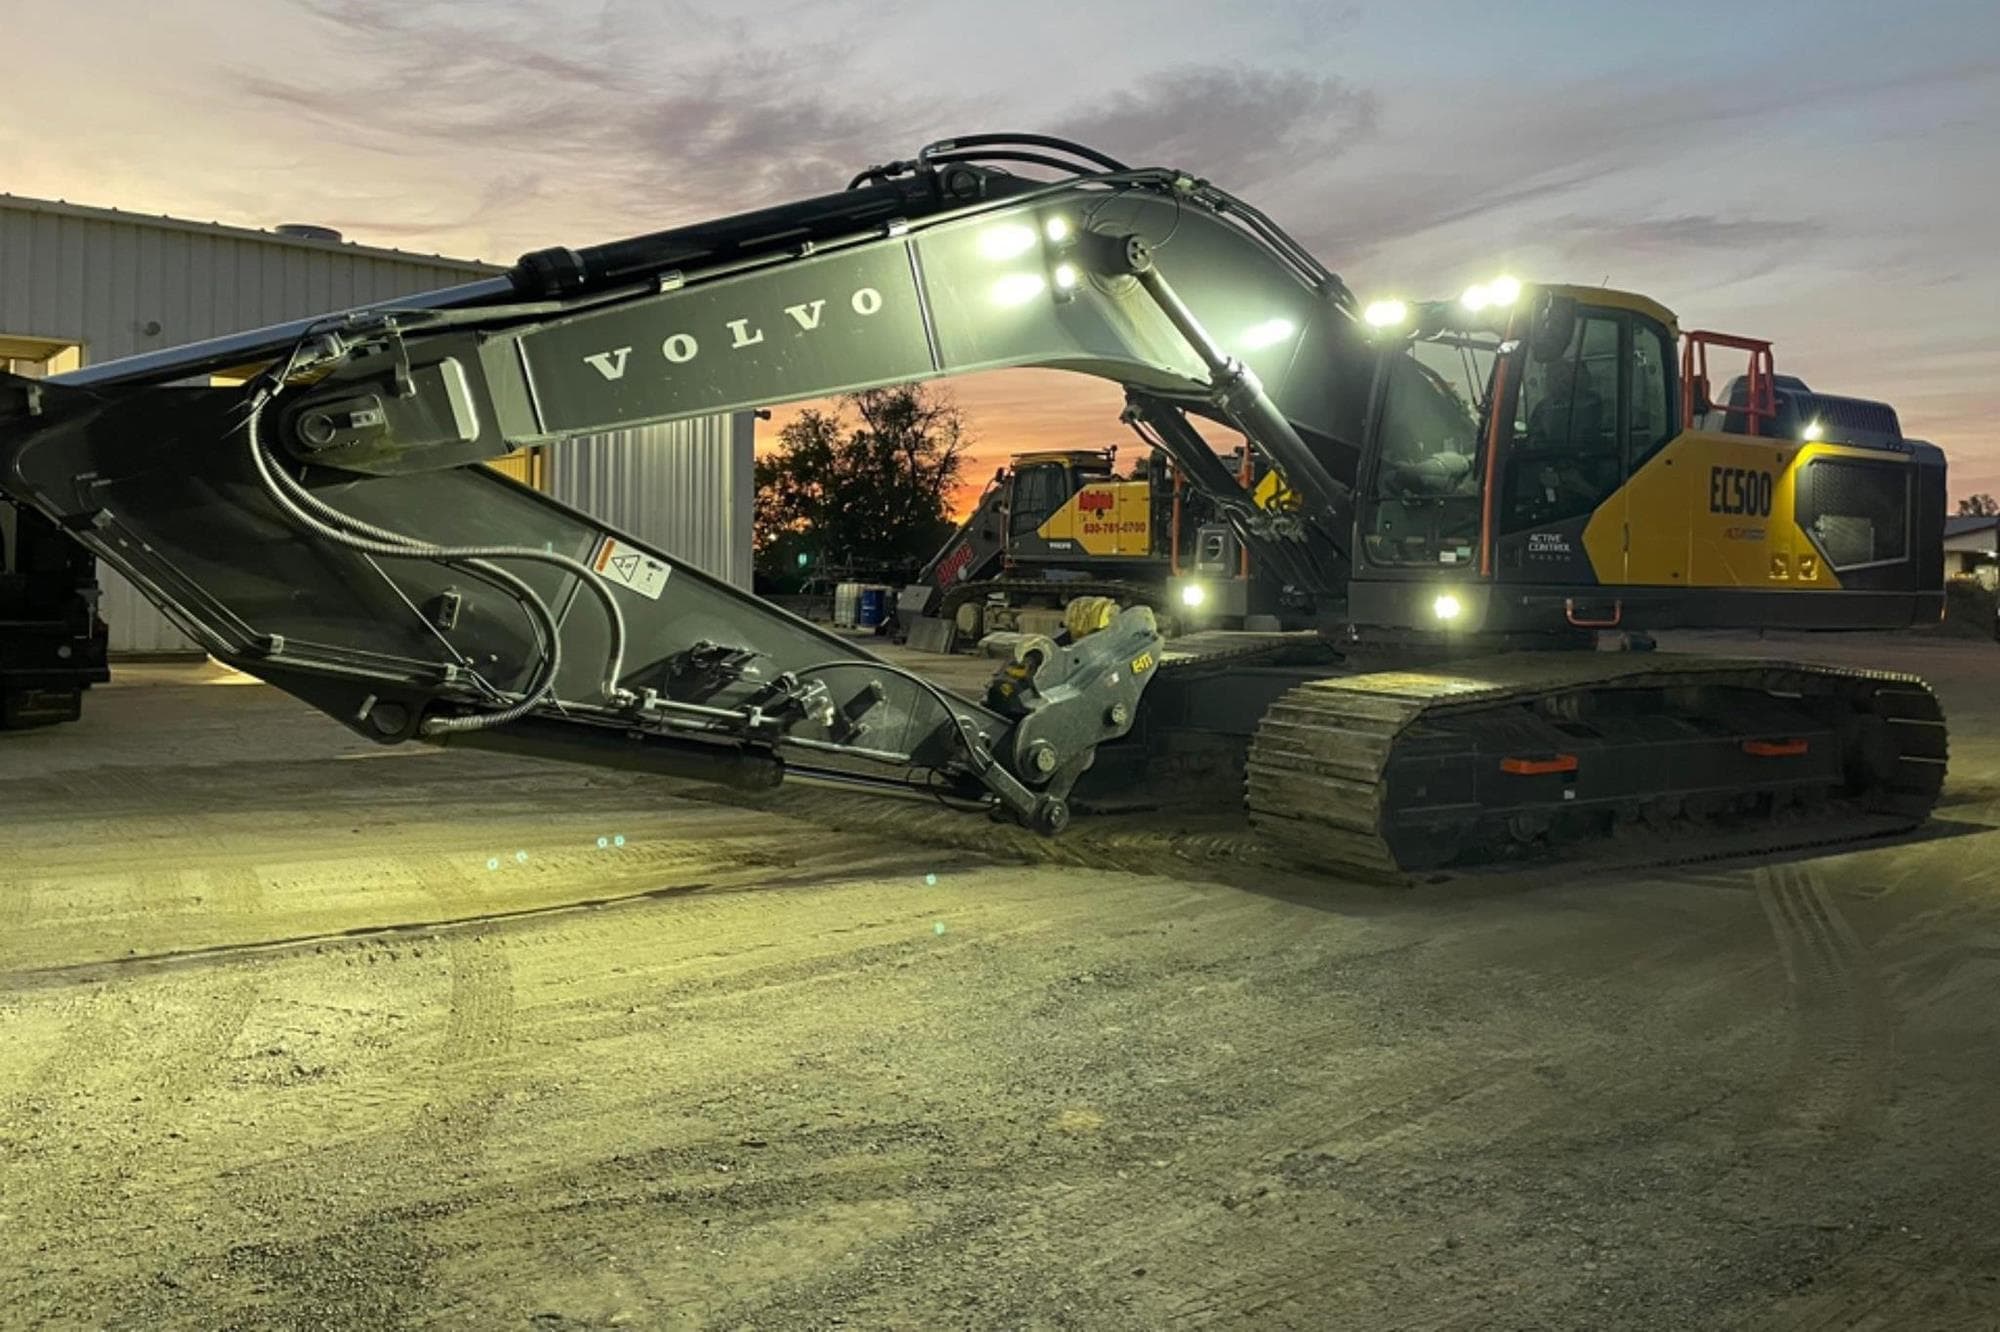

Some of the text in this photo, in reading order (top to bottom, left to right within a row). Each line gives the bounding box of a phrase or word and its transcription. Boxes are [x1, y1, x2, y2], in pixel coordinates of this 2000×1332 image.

[584, 287, 883, 382] VOLVO
[1710, 466, 1772, 517] EC500
[1528, 543, 1571, 551] CONTROL
[1529, 533, 1563, 543] ACTIVE
